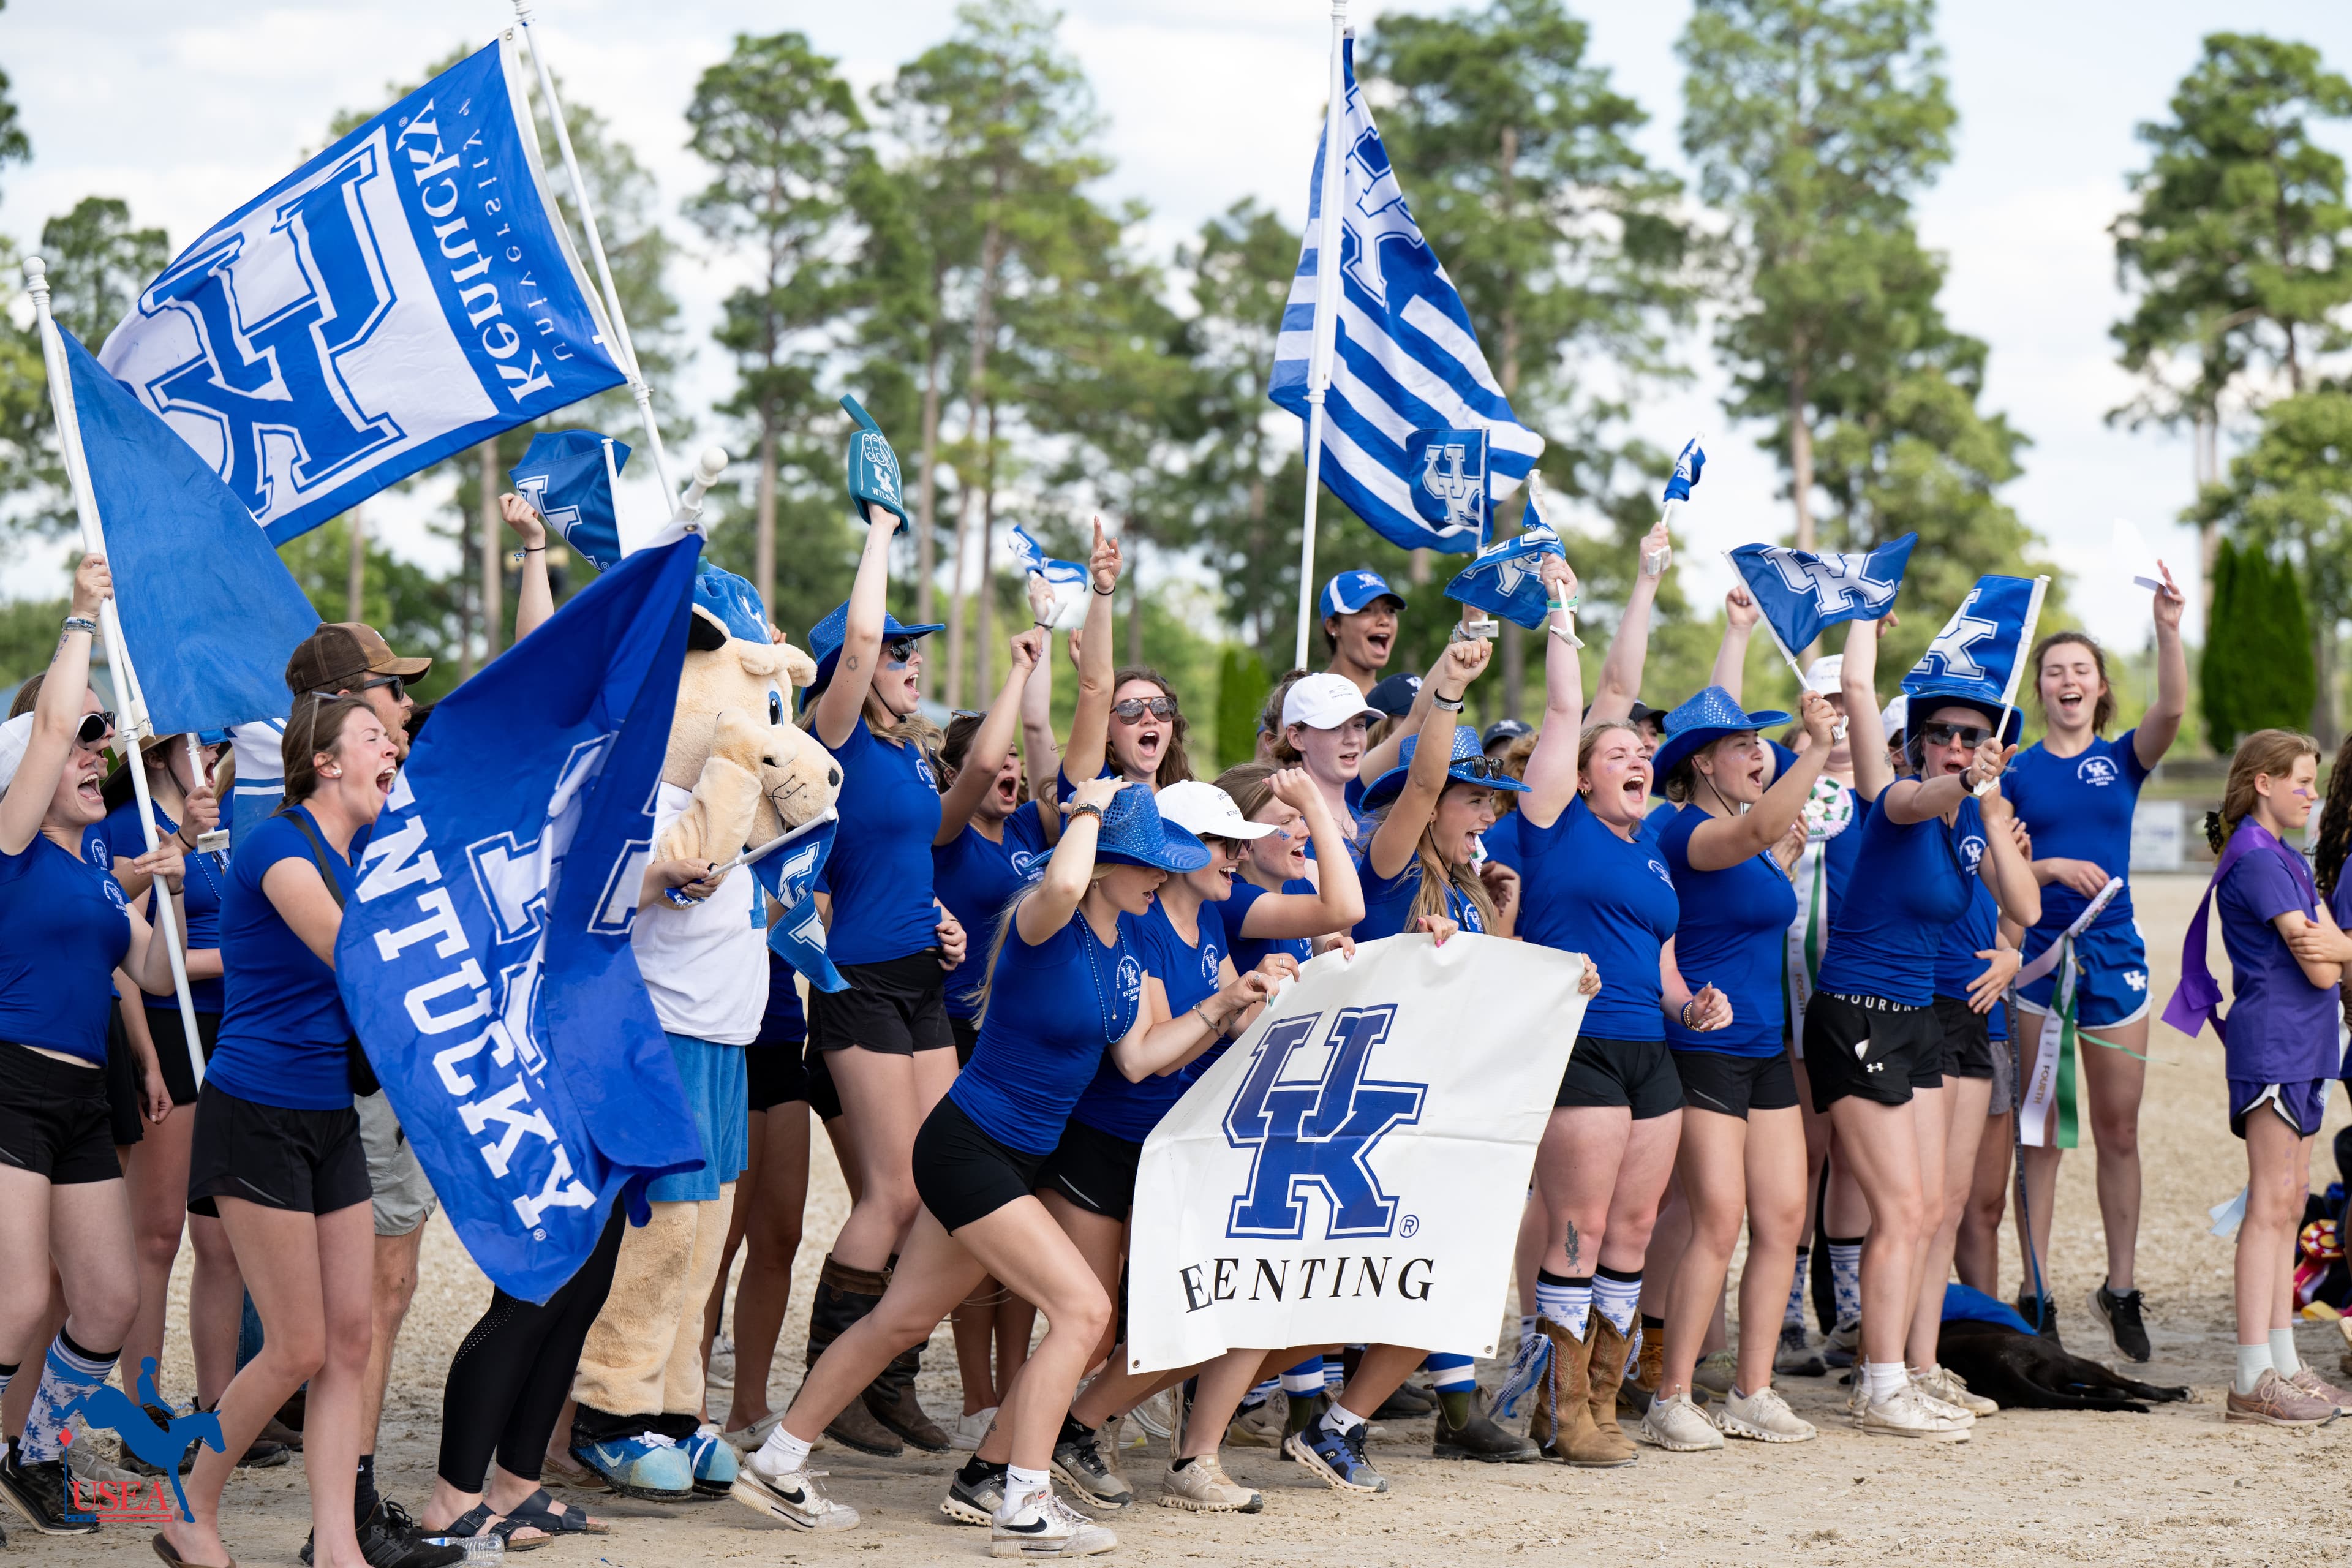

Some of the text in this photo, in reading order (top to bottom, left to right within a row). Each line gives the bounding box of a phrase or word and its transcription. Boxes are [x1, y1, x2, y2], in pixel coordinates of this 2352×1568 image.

[873, 463, 897, 500] UK
[1757, 546, 1896, 618] UK
[2084, 761, 2111, 777] UK
[1121, 963, 1139, 986] UK
[2122, 970, 2146, 991] UK
[2034, 1065, 2051, 1104] FOURTH
[1221, 1003, 1430, 1240] UK
